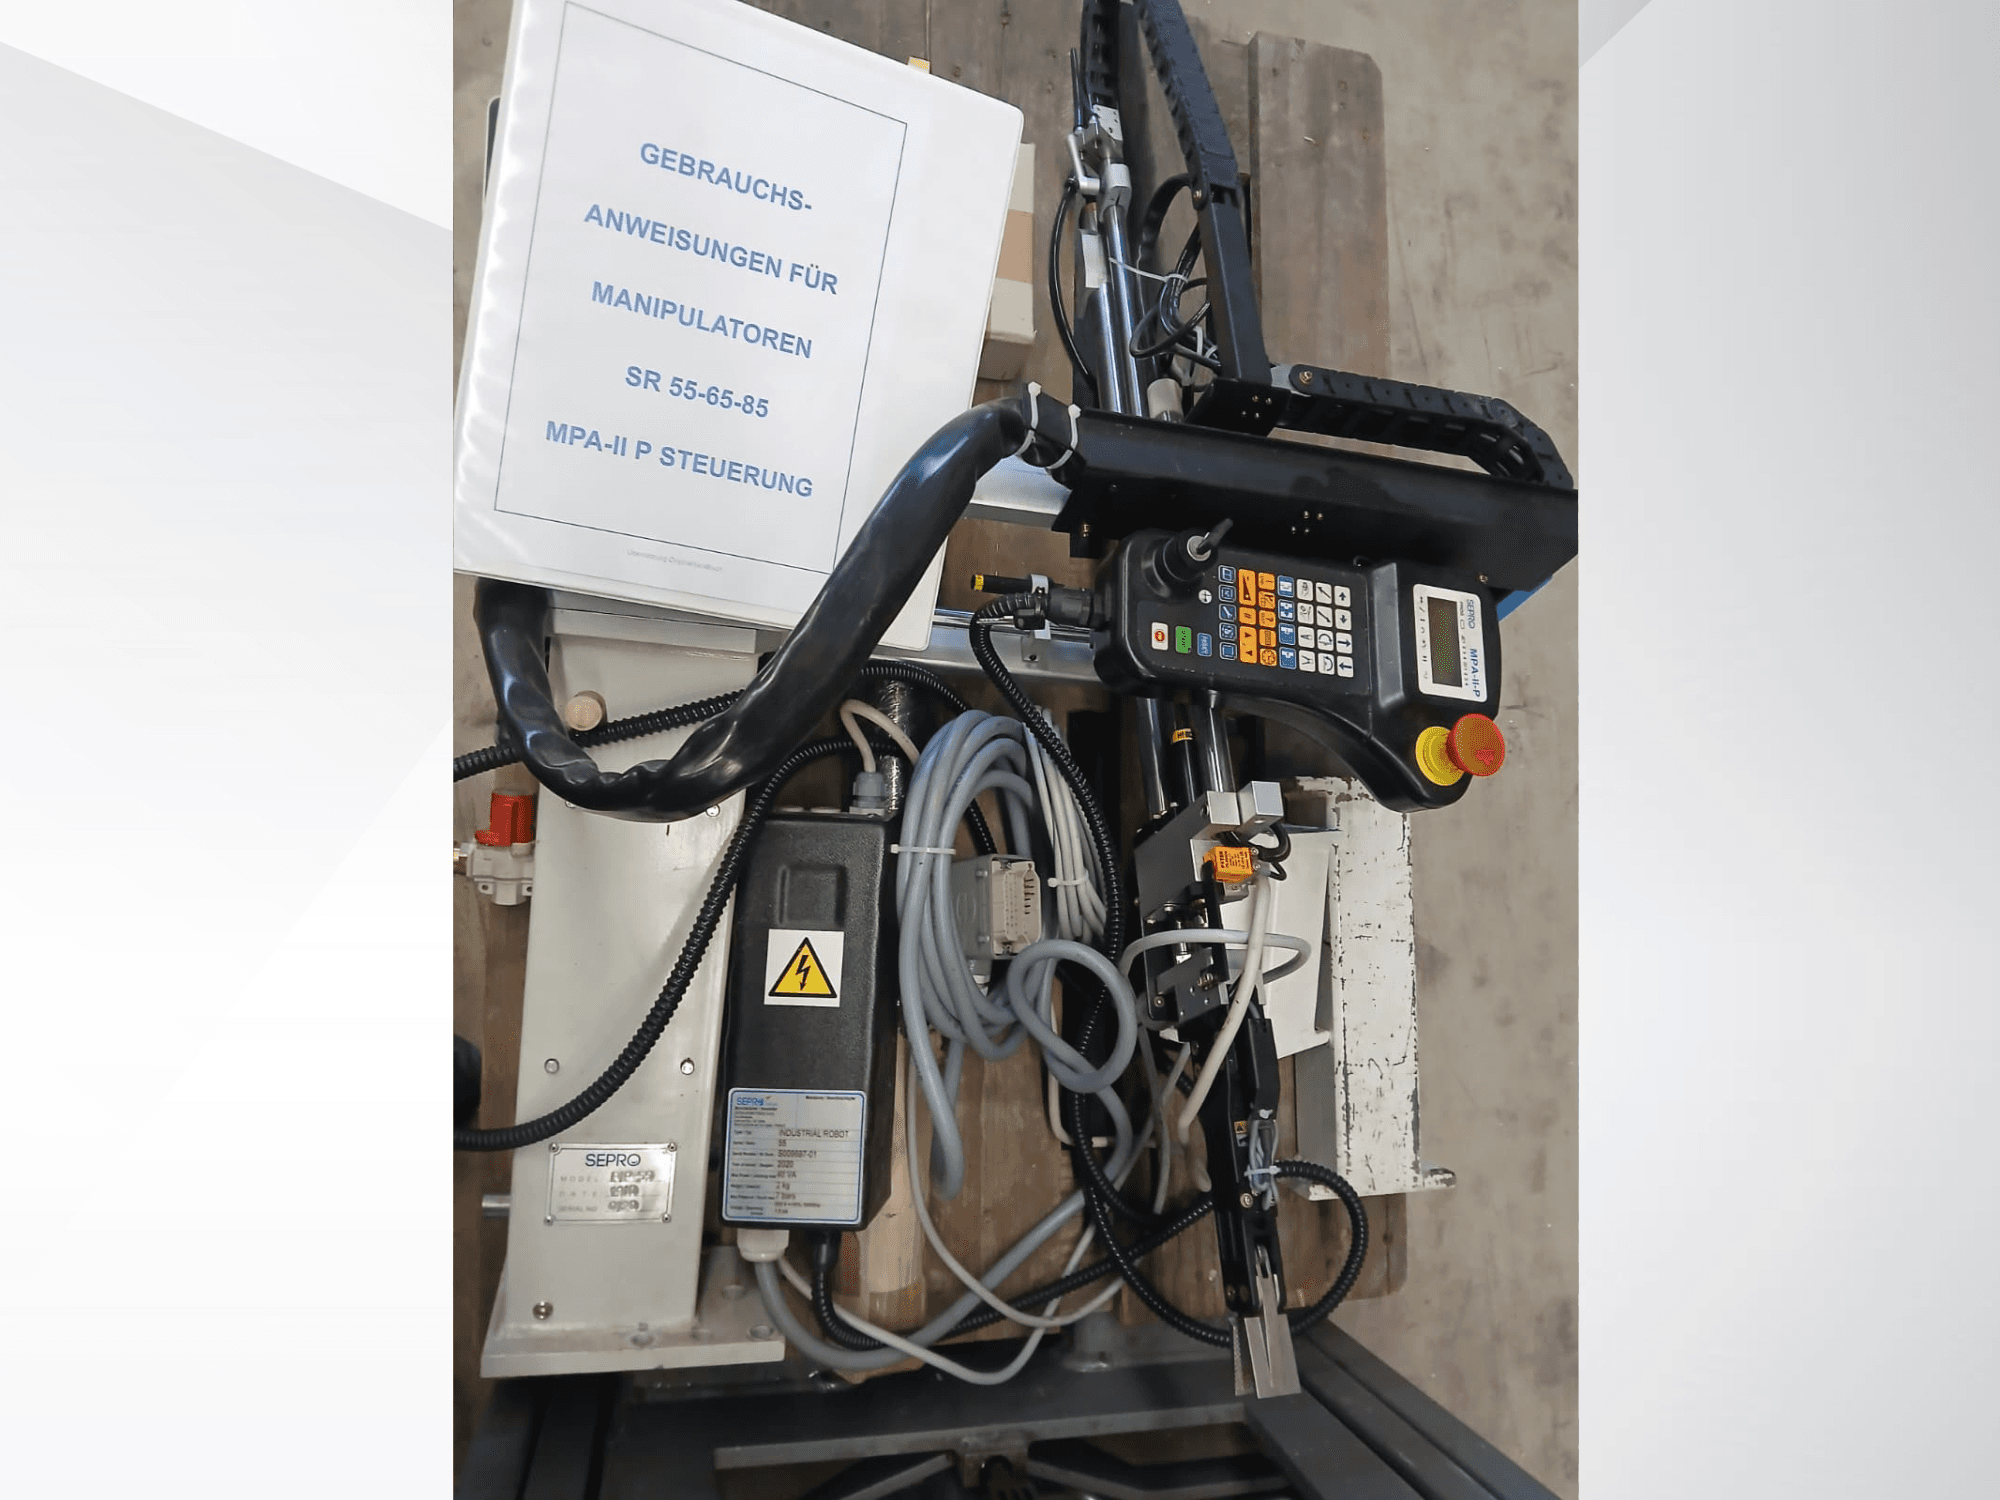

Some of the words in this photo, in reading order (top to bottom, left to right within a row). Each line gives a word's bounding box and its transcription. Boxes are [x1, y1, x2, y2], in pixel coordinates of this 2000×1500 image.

[640, 142, 813, 211] GEBRAUCHS-
[584, 203, 783, 278] ANWEISUNGEN
[789, 262, 839, 295] FÜR
[591, 281, 812, 359] MANIPULATOREN
[625, 366, 661, 393] SR
[669, 377, 770, 418] 55-65-85
[546, 420, 627, 459] MPA-II
[636, 440, 652, 460] P
[659, 446, 813, 499] STEUERUNG
[1466, 599, 1476, 630] SEPRO
[585, 1153, 642, 1167] SEPRO
[779, 1129, 821, 1138] INDUSTRIAL
[823, 1130, 849, 1138] ROBOT
